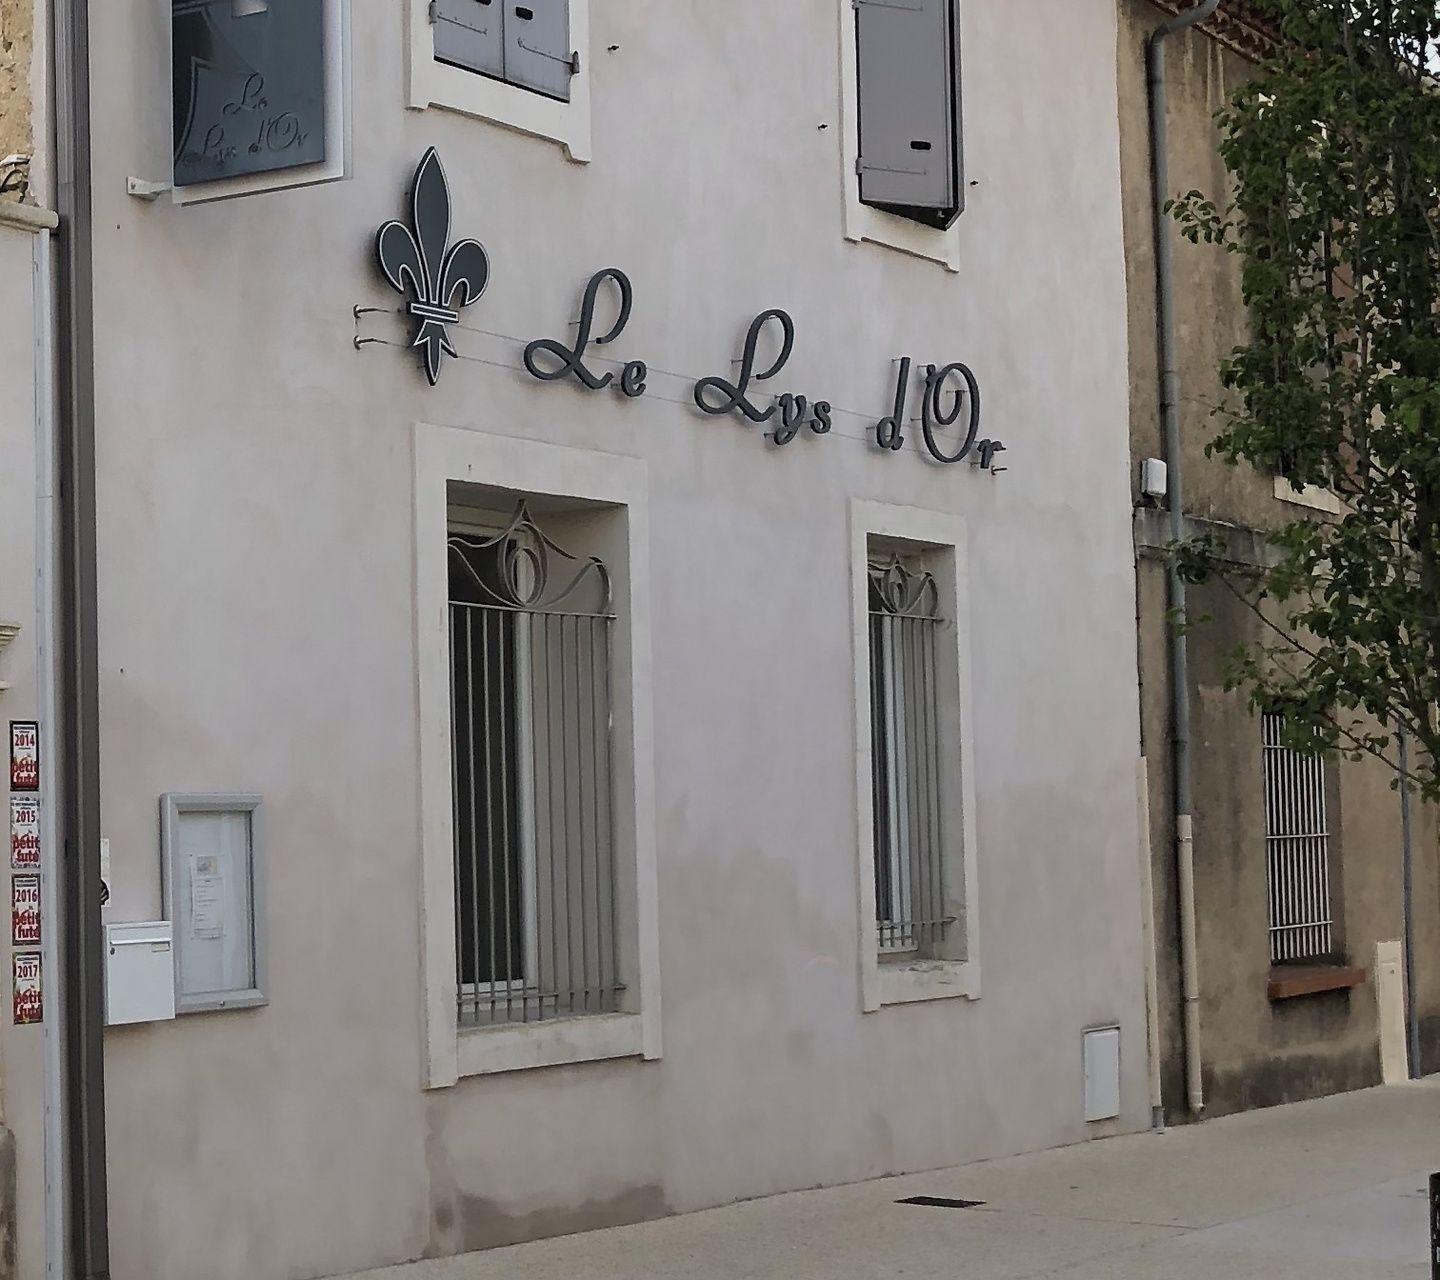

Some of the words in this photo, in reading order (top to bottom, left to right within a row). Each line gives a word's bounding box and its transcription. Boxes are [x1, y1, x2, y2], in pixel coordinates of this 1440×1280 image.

[523, 267, 647, 398] Le
[694, 308, 832, 446] Lys
[875, 355, 1007, 470] d'Or
[15, 734, 35, 747] 2014
[16, 810, 36, 824] 2015
[16, 889, 37, 903] 2016
[18, 965, 37, 978] 2017
